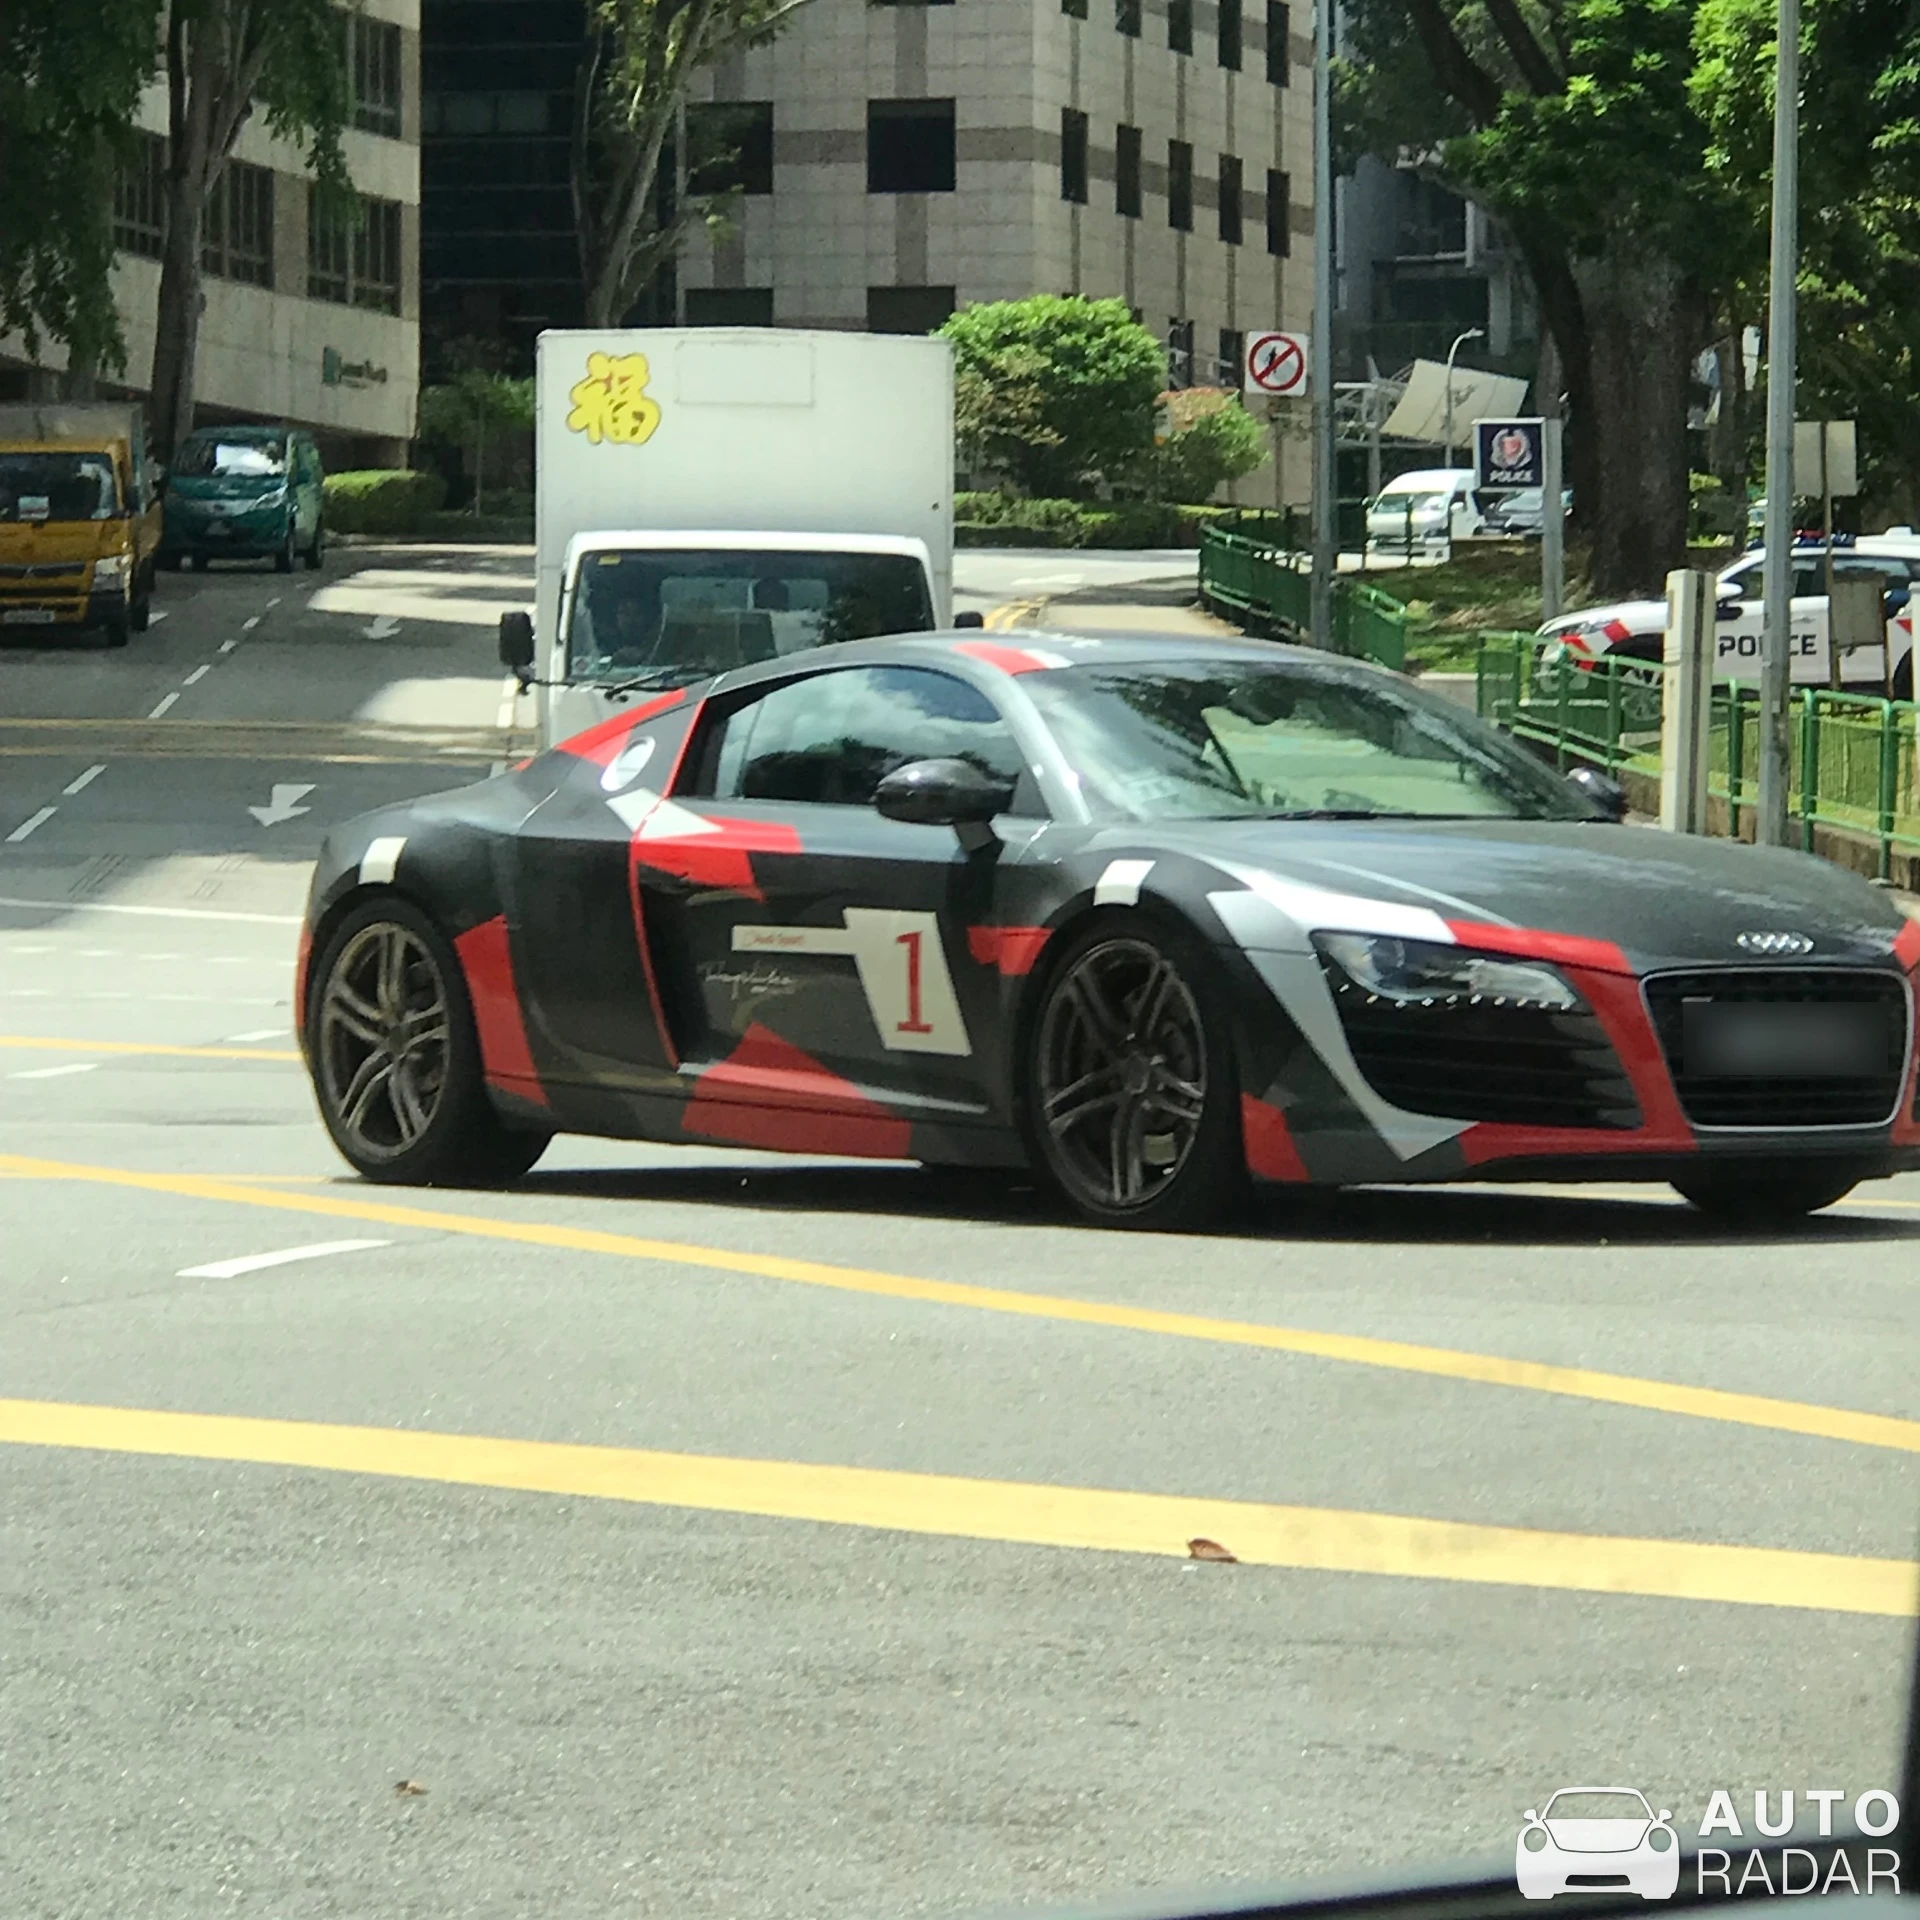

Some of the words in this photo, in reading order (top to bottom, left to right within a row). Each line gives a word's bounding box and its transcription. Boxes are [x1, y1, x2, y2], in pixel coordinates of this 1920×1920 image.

[566, 352, 661, 446] 福
[1489, 469, 1533, 482] POLICE
[896, 930, 933, 1034] 1
